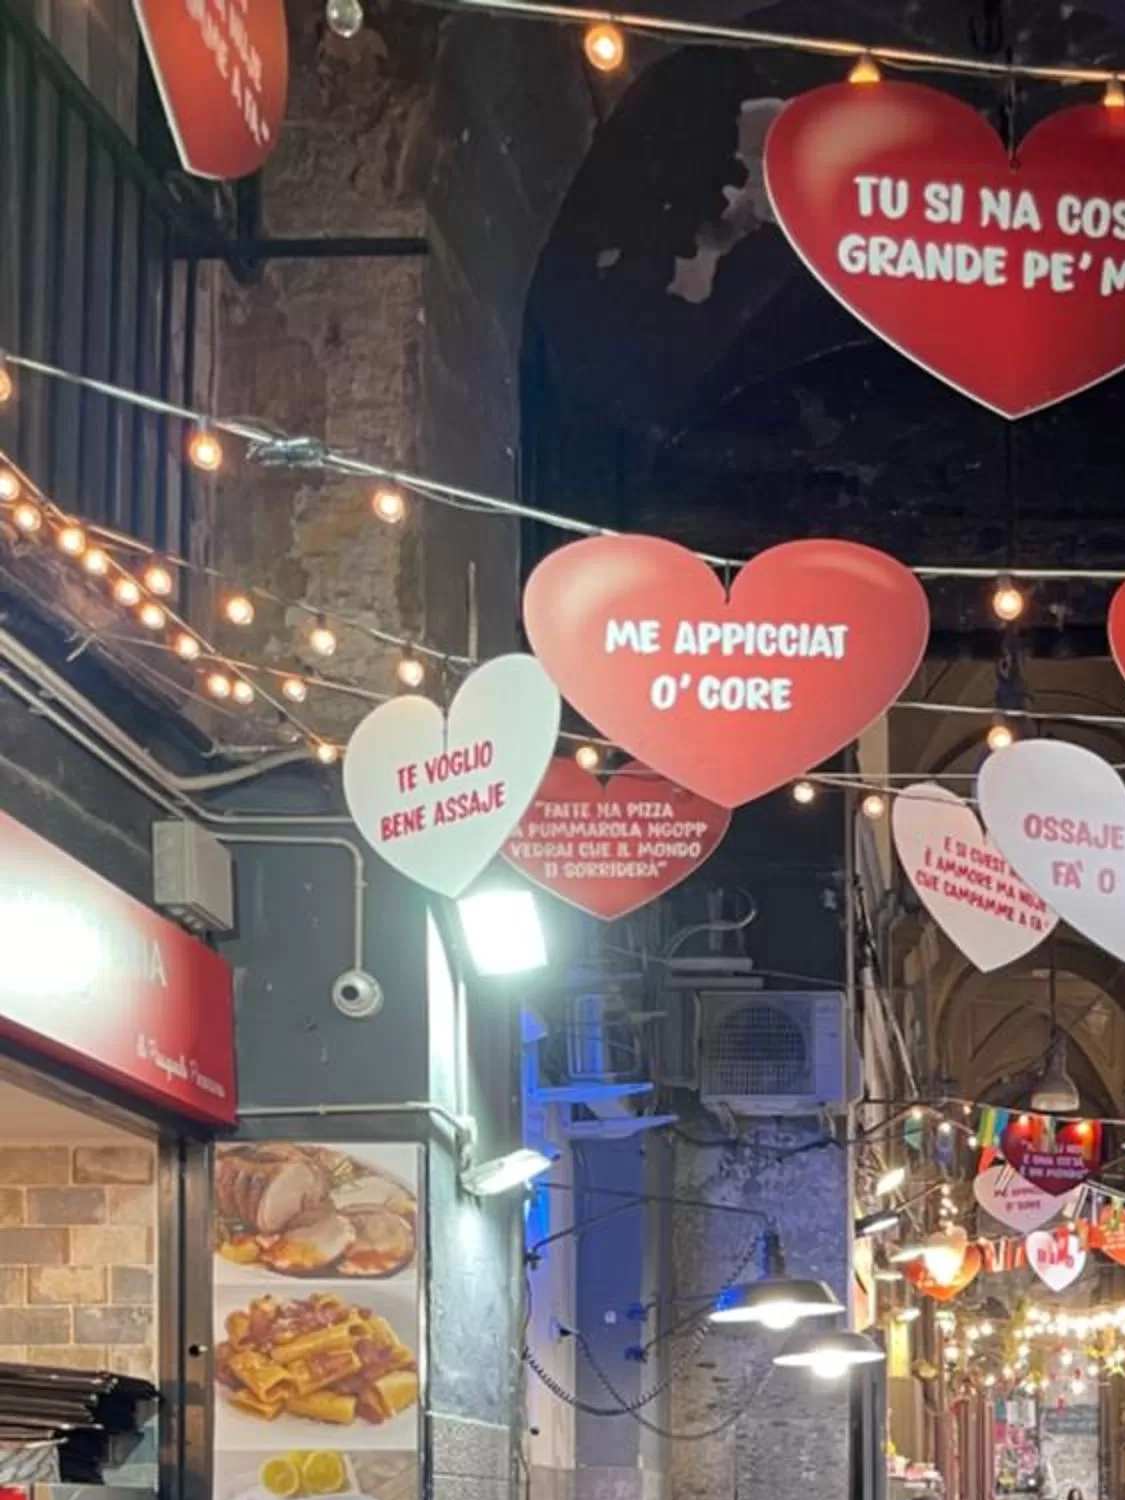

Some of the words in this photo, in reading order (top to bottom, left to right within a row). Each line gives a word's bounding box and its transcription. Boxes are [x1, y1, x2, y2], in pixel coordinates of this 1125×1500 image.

[854, 175, 908, 219] TU
[924, 182, 964, 225] SI
[980, 187, 1042, 233] NA
[838, 234, 1007, 286] GRANDE
[605, 619, 661, 655] ME
[674, 620, 848, 660] APPICCIAT
[397, 763, 418, 793] TE
[424, 740, 494, 785] VOGLIO
[380, 805, 426, 842] BENE
[433, 782, 506, 827] ASSAJE
[627, 801, 674, 818] PIZZA
[511, 842, 573, 858] VEDRAI
[578, 842, 611, 858] CHE
[638, 841, 702, 858] MONDO
[1023, 813, 1125, 850] OSSAJE
[1098, 867, 1117, 895] O
